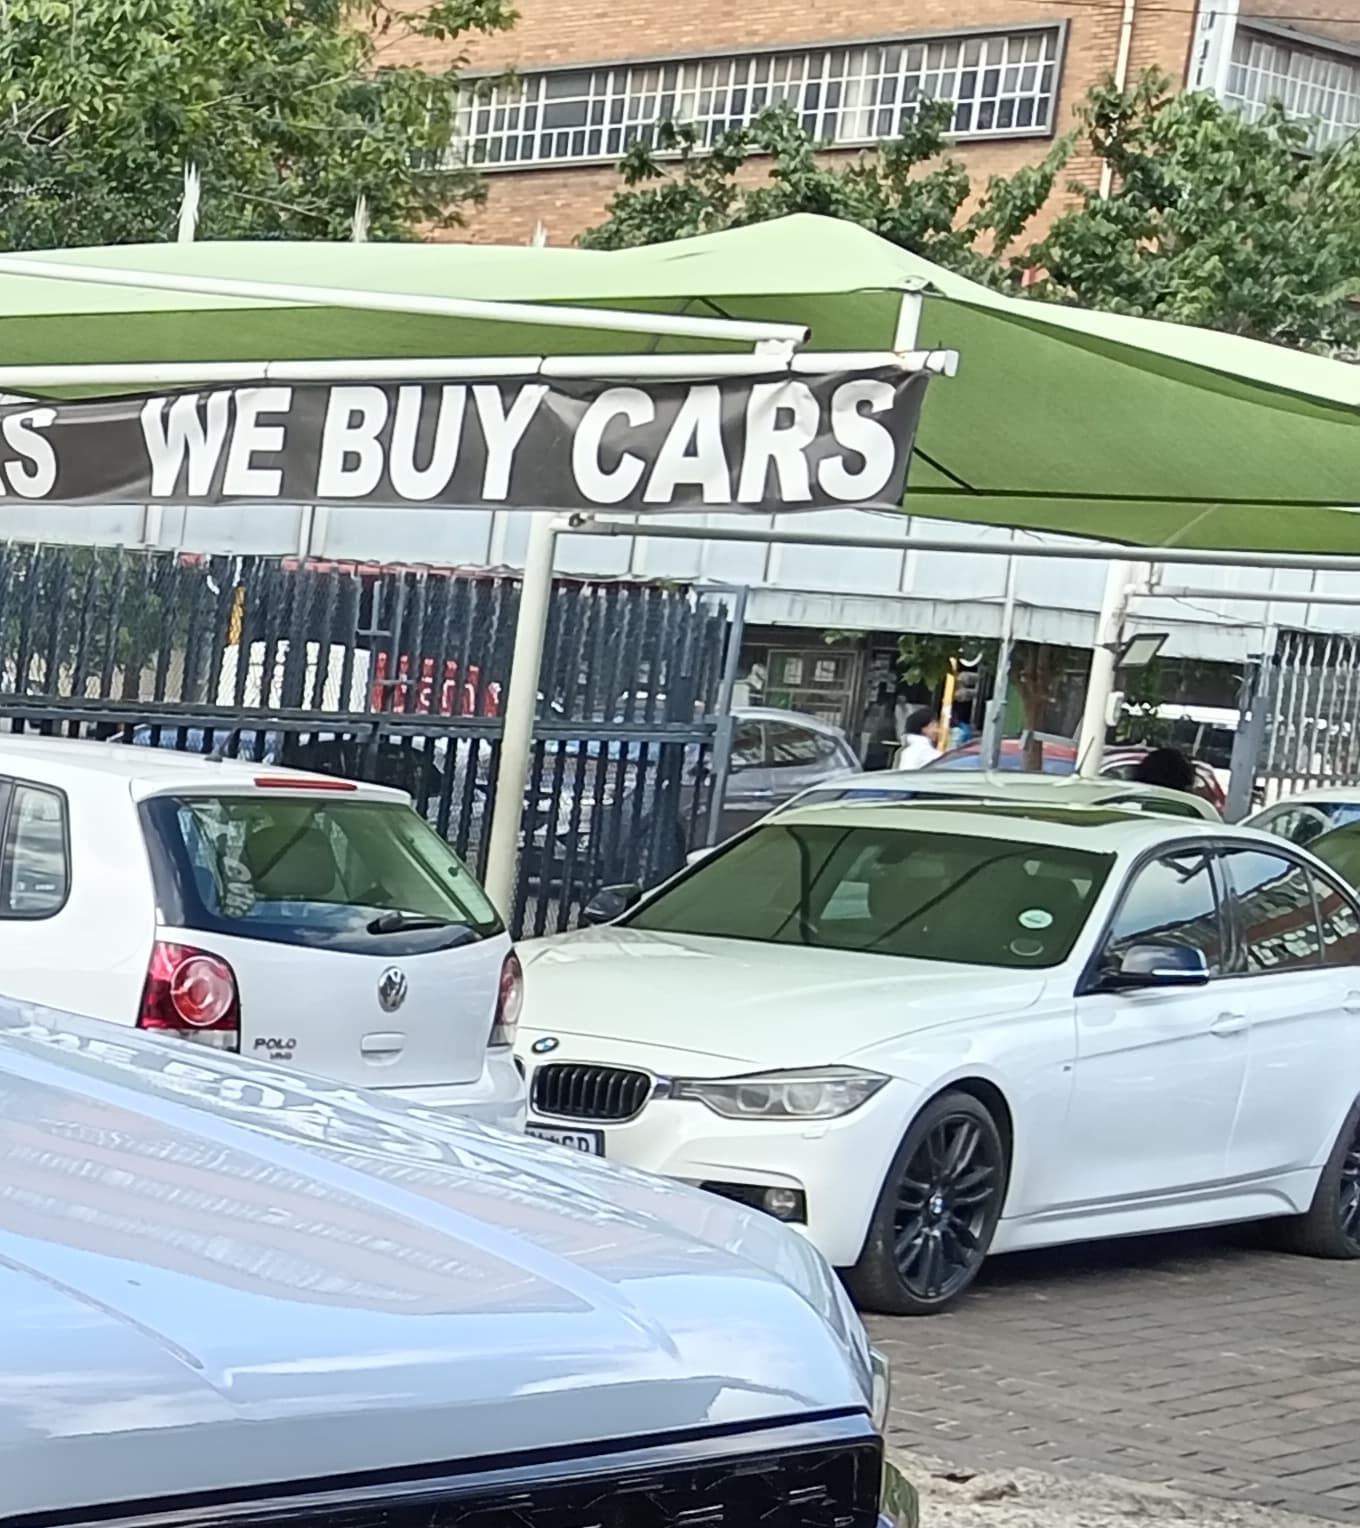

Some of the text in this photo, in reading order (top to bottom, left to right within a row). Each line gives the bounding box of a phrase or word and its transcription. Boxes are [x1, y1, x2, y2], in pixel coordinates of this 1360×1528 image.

[138, 385, 293, 497] WE
[316, 381, 551, 501] BUY
[571, 378, 897, 505] CARS
[253, 1037, 297, 1050] POLO
